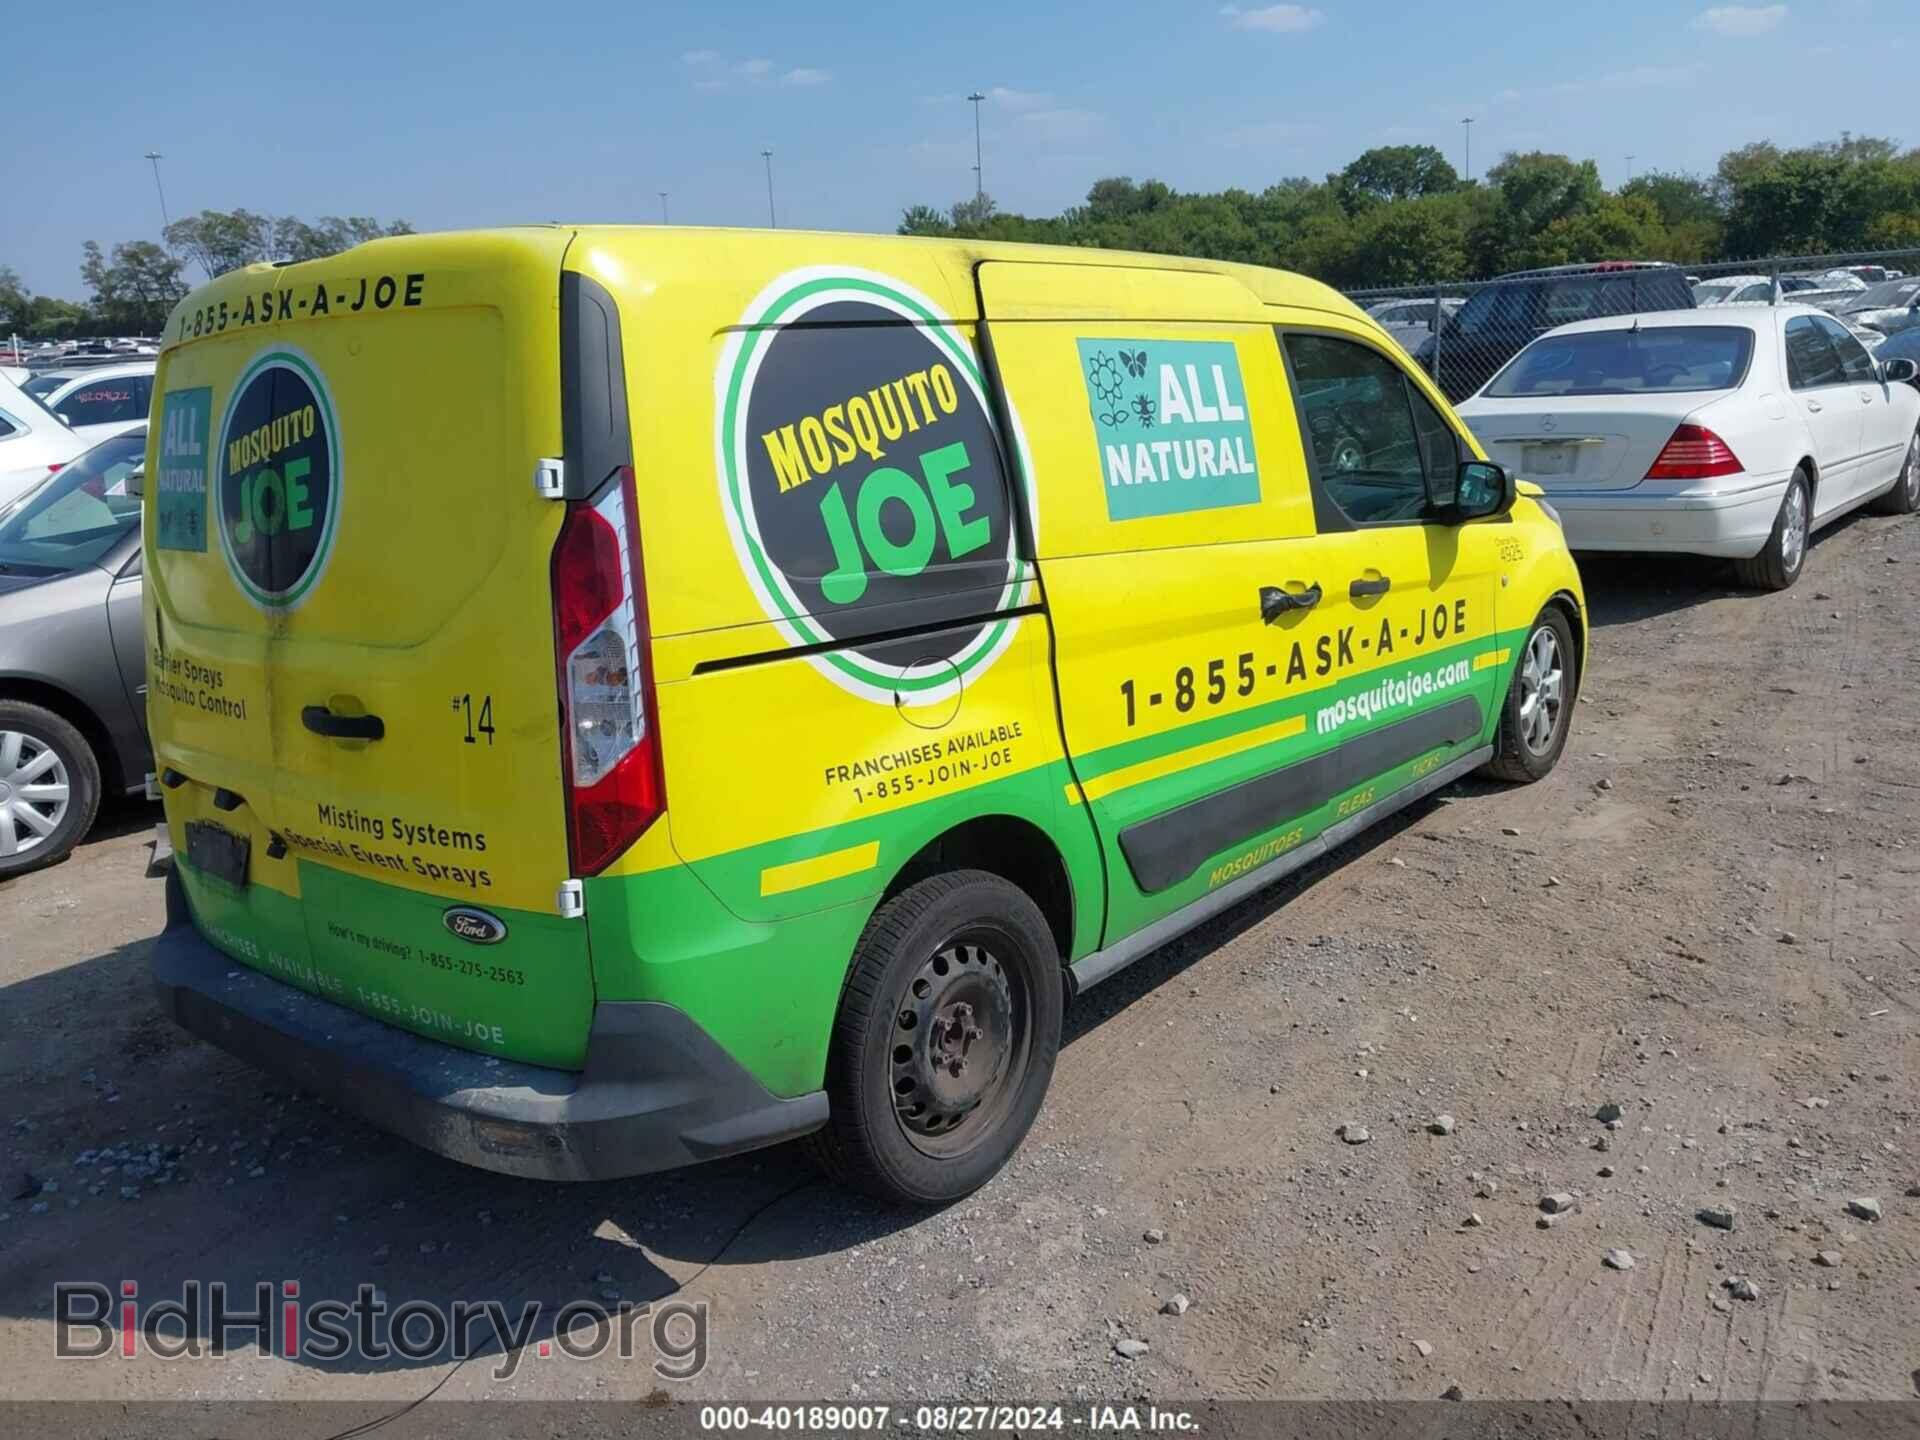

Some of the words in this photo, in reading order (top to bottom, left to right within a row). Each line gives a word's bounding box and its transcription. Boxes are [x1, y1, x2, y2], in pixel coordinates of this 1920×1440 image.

[179, 273, 425, 341] 1-855-ASK-A-JOE
[1159, 364, 1244, 424] ALL
[164, 407, 201, 457] ALL
[228, 405, 315, 475] MOSQUITO
[762, 363, 958, 493] MOSQUITO
[1104, 438, 1255, 486] NATURAL
[235, 456, 314, 543] JOE
[819, 441, 991, 604] JOE
[184, 659, 224, 689] Sprays
[1120, 599, 1466, 727] 1-855-ASK-A-JOE
[199, 689, 247, 720] Control
[452, 694, 495, 745] #14
[1316, 658, 1470, 735] mosquitojoe.com
[825, 743, 942, 786] FRANCHISES
[947, 721, 1022, 756] AVAILABLE
[853, 747, 1012, 804] 1-855-JOIN-JOE
[284, 827, 349, 858] Special
[350, 843, 409, 872] Event
[412, 856, 492, 888] Sprays
[318, 803, 384, 840] Misting
[392, 817, 487, 851] Systems
[1208, 827, 1303, 887] MOSQUITOES
[1335, 787, 1376, 817] FLEAS
[454, 916, 487, 938] Ford
[203, 921, 260, 960] ANCHISES
[268, 951, 343, 993] AVAILABLE
[357, 986, 505, 1045] 1-855-JOIN-JOE
[357, 933, 370, 949] my
[419, 949, 525, 986] 1-855-275-2563
